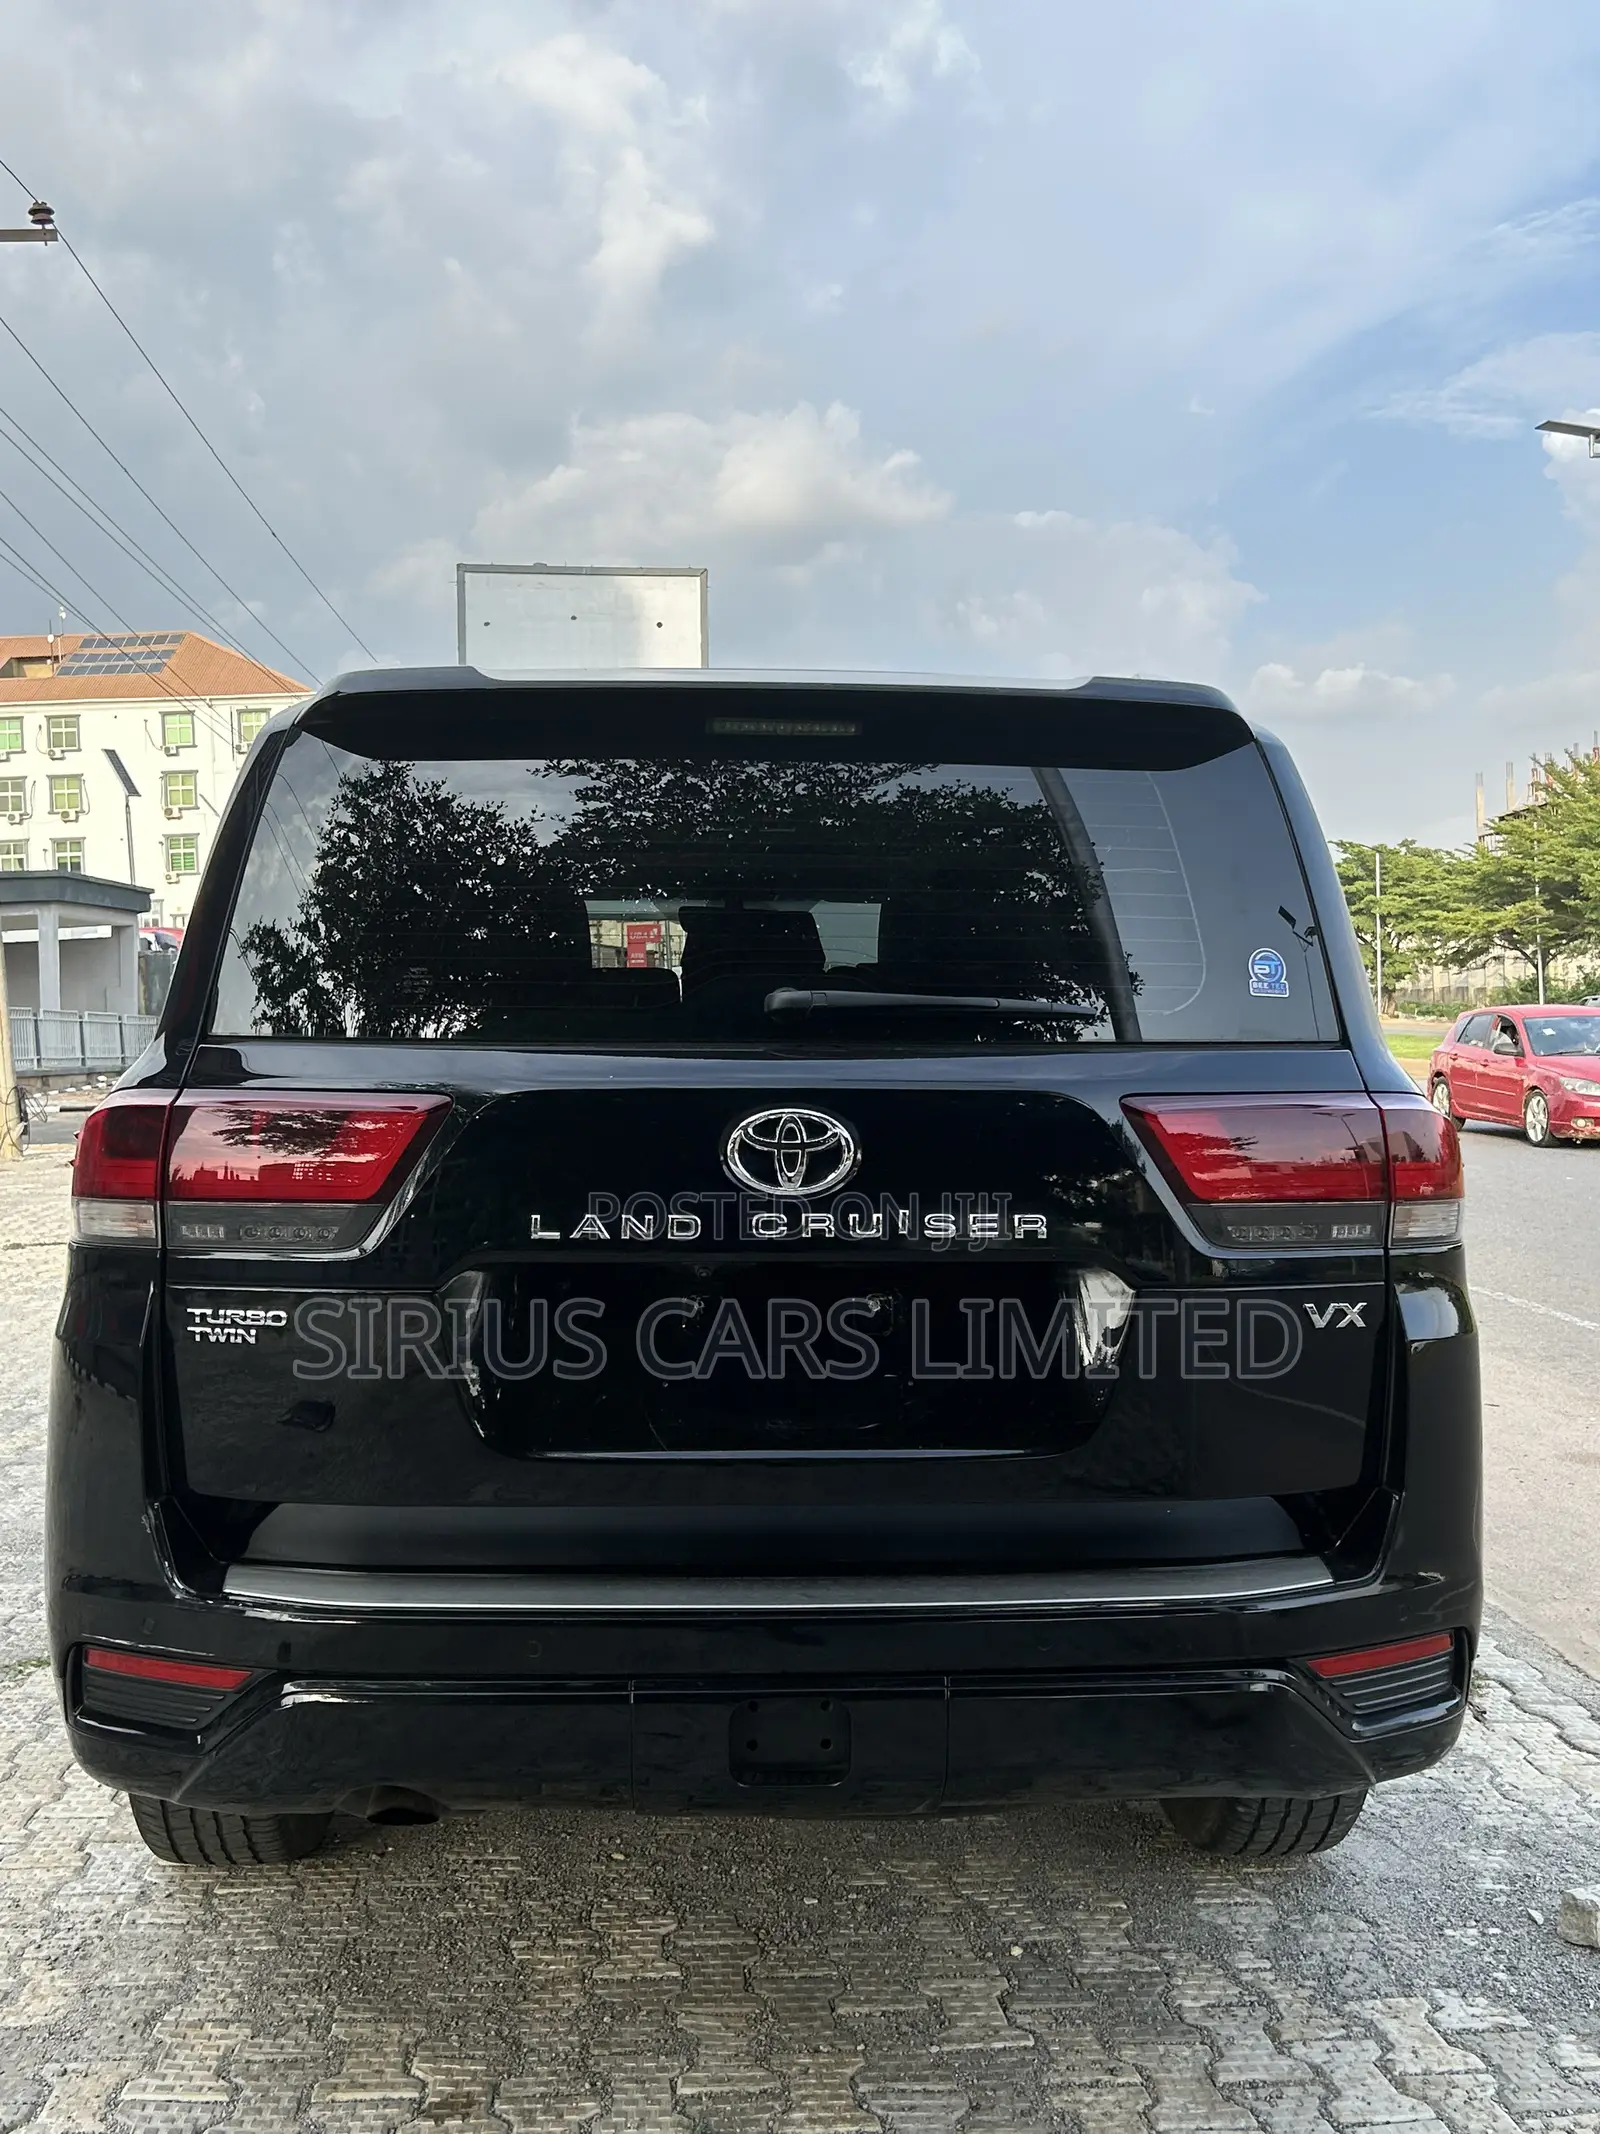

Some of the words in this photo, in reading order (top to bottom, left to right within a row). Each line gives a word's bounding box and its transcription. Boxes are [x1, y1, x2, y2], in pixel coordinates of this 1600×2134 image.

[531, 1214, 701, 1239] LAND
[752, 1210, 1048, 1239] CRUISER
[186, 1308, 288, 1326] TURBO
[1302, 1302, 1367, 1328] VX
[186, 1326, 257, 1344] TWIN
